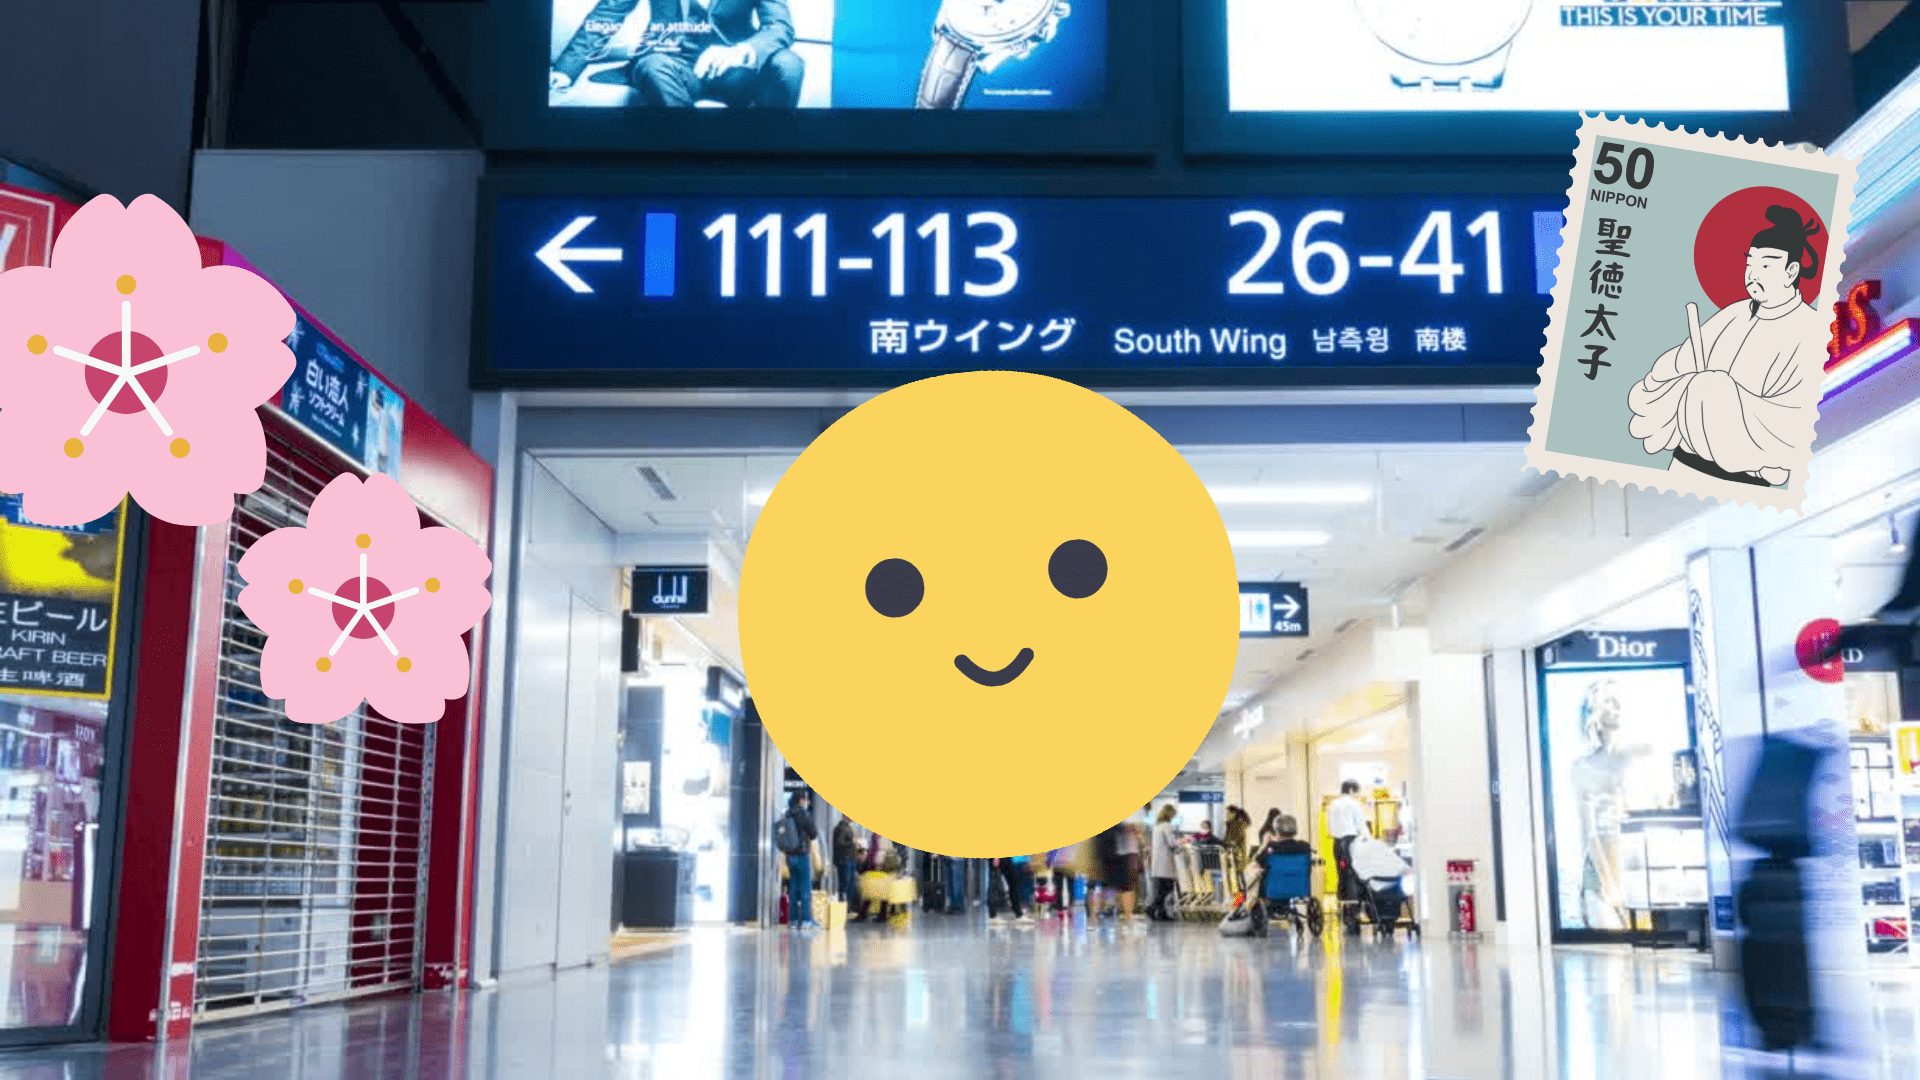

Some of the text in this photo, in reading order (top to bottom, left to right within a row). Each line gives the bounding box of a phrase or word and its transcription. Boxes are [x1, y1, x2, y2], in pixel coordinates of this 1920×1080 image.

[1561, 6, 1768, 26] THIS IS YOUR TIME
[703, 211, 1019, 297] 111-113
[1228, 210, 1503, 296] 26-41
[869, 317, 1076, 354] 南ウイング
[1114, 327, 1287, 360] South Wing
[1312, 327, 1389, 354] 남측윙
[1414, 327, 1467, 353] 南楼
[0, 600, 108, 632] ビール
[1274, 620, 1302, 632] 45m
[11, 628, 67, 646] KIRIN
[1597, 636, 1657, 658] Dior
[0, 646, 107, 667] AFT BEER
